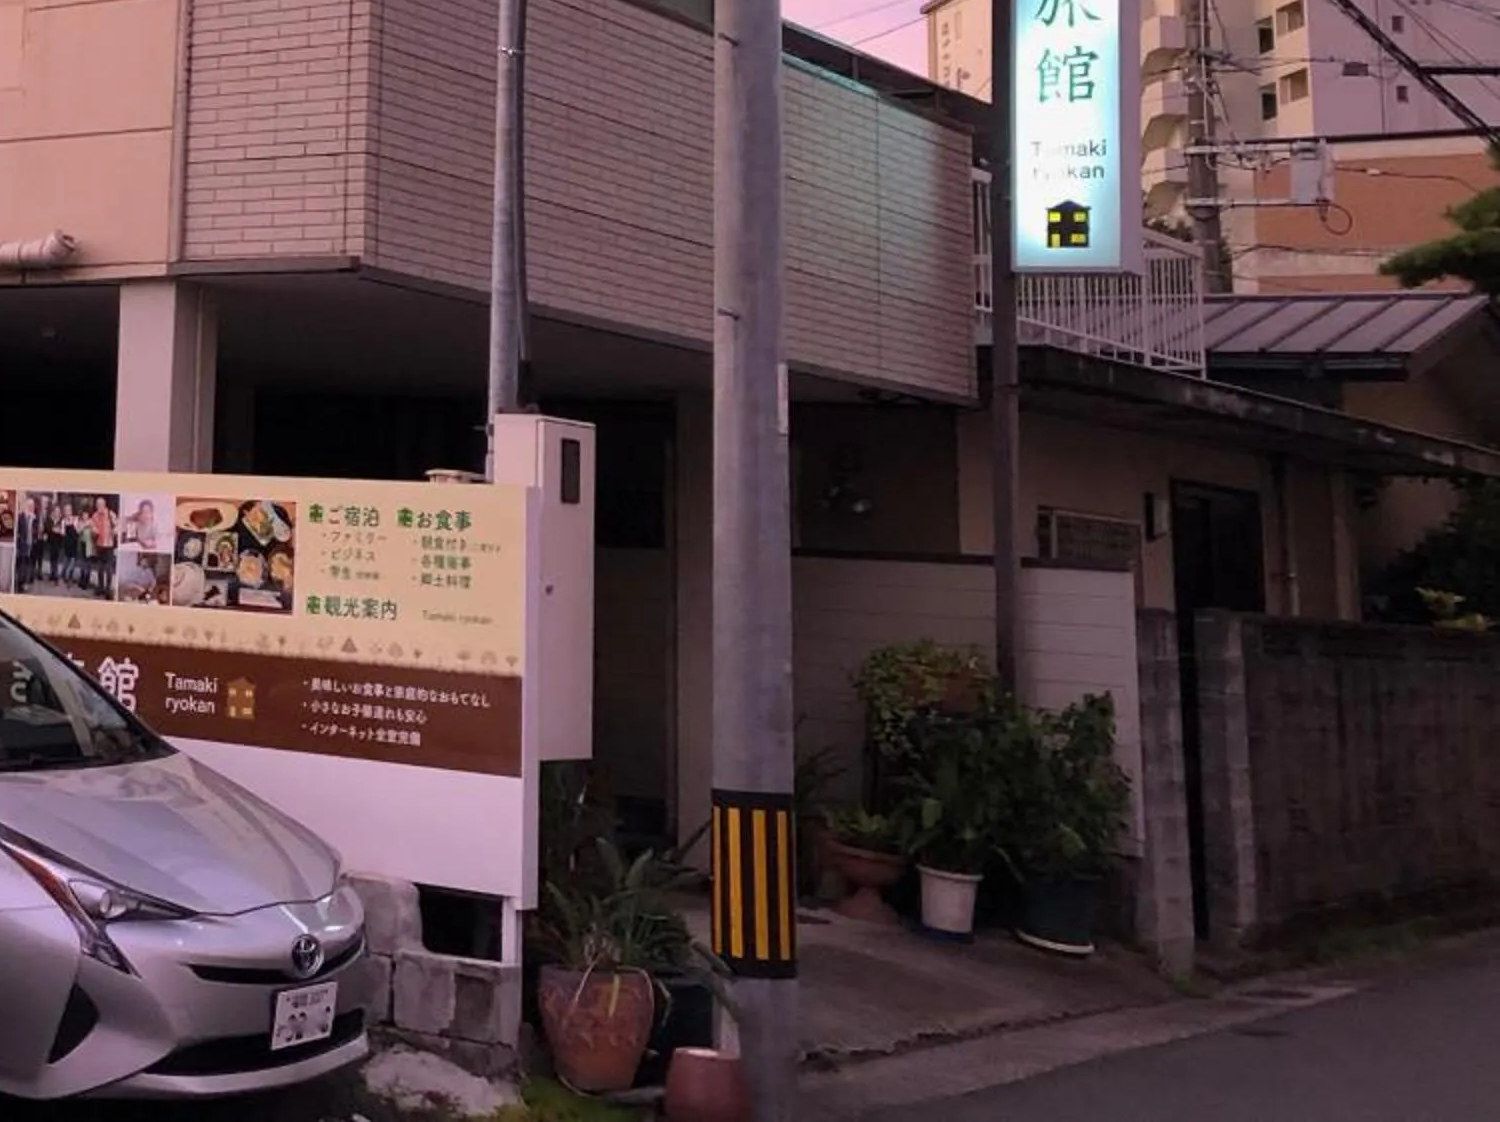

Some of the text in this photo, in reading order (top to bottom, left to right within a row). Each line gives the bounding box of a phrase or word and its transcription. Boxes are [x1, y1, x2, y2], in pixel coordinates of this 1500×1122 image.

[1030, 139, 1107, 157] Tmaki
[327, 504, 380, 528] ご宿泊
[416, 509, 473, 532] お食事
[324, 595, 398, 621] 観光案内
[164, 671, 218, 694] Tamaki
[165, 694, 217, 715] ryokan
